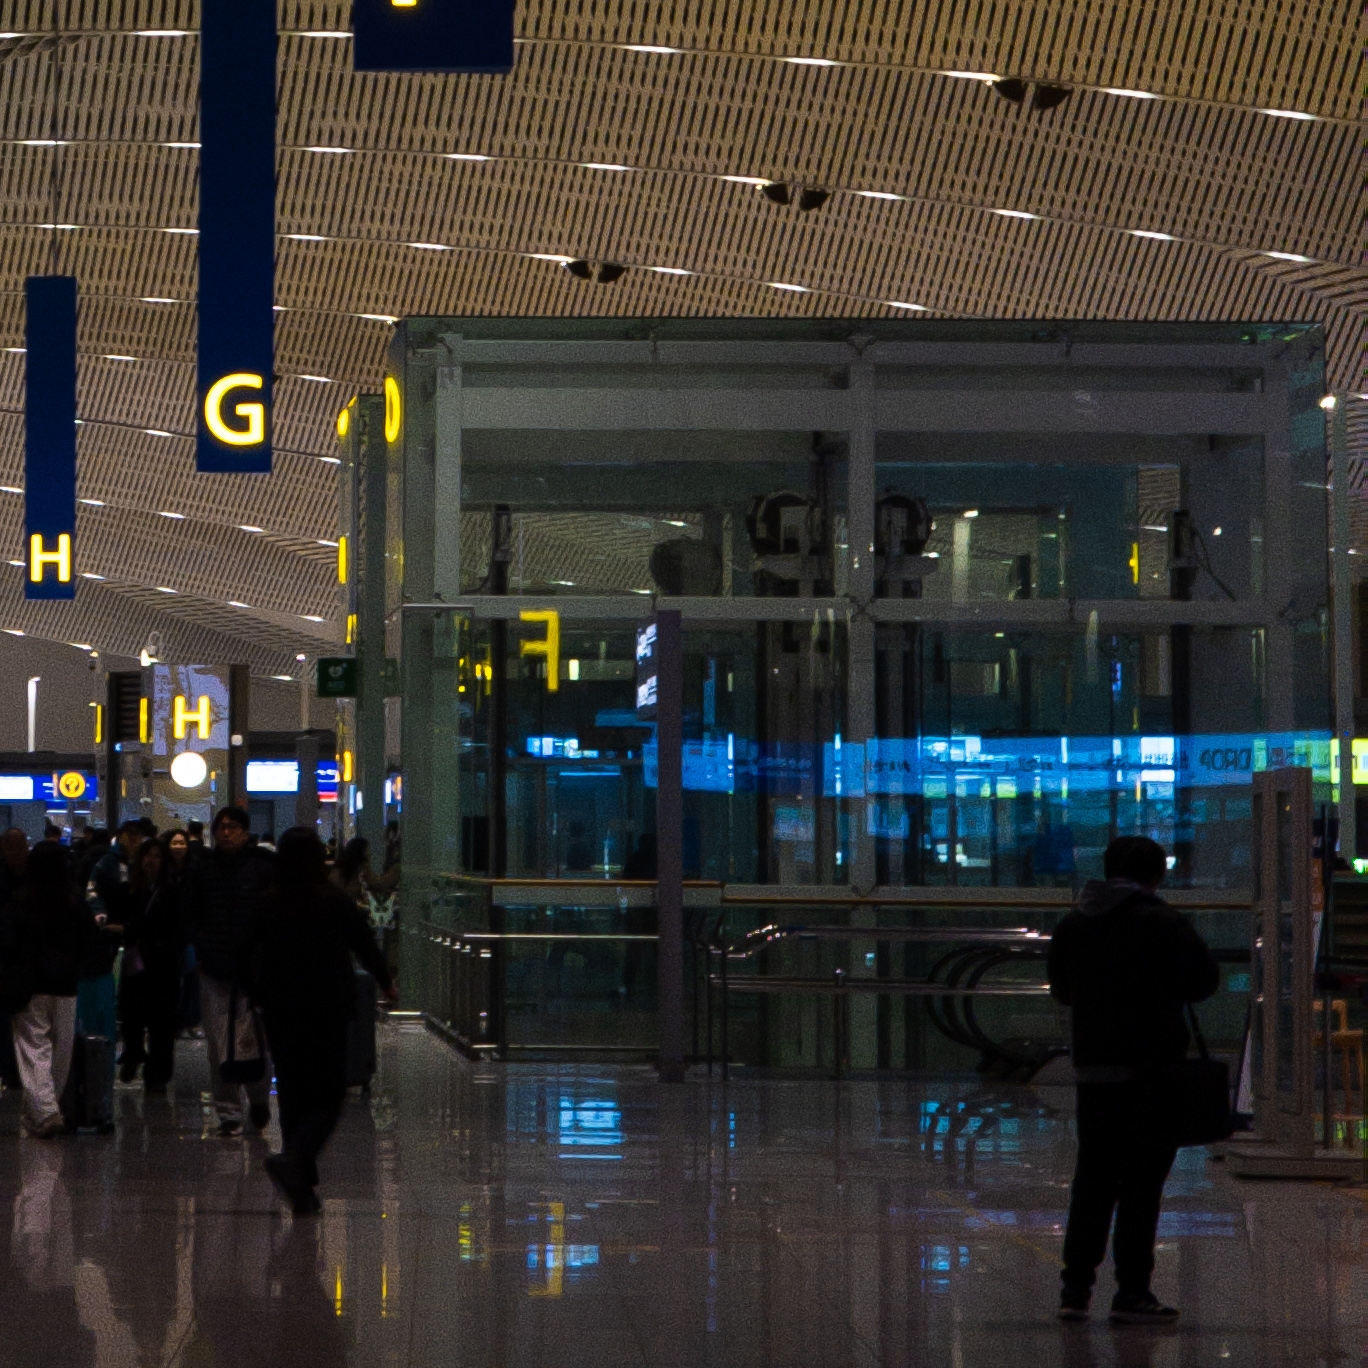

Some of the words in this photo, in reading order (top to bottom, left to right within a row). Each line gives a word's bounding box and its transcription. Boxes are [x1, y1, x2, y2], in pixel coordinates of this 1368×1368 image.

[203, 372, 265, 446] G
[30, 533, 72, 583] H
[172, 694, 212, 740] H
